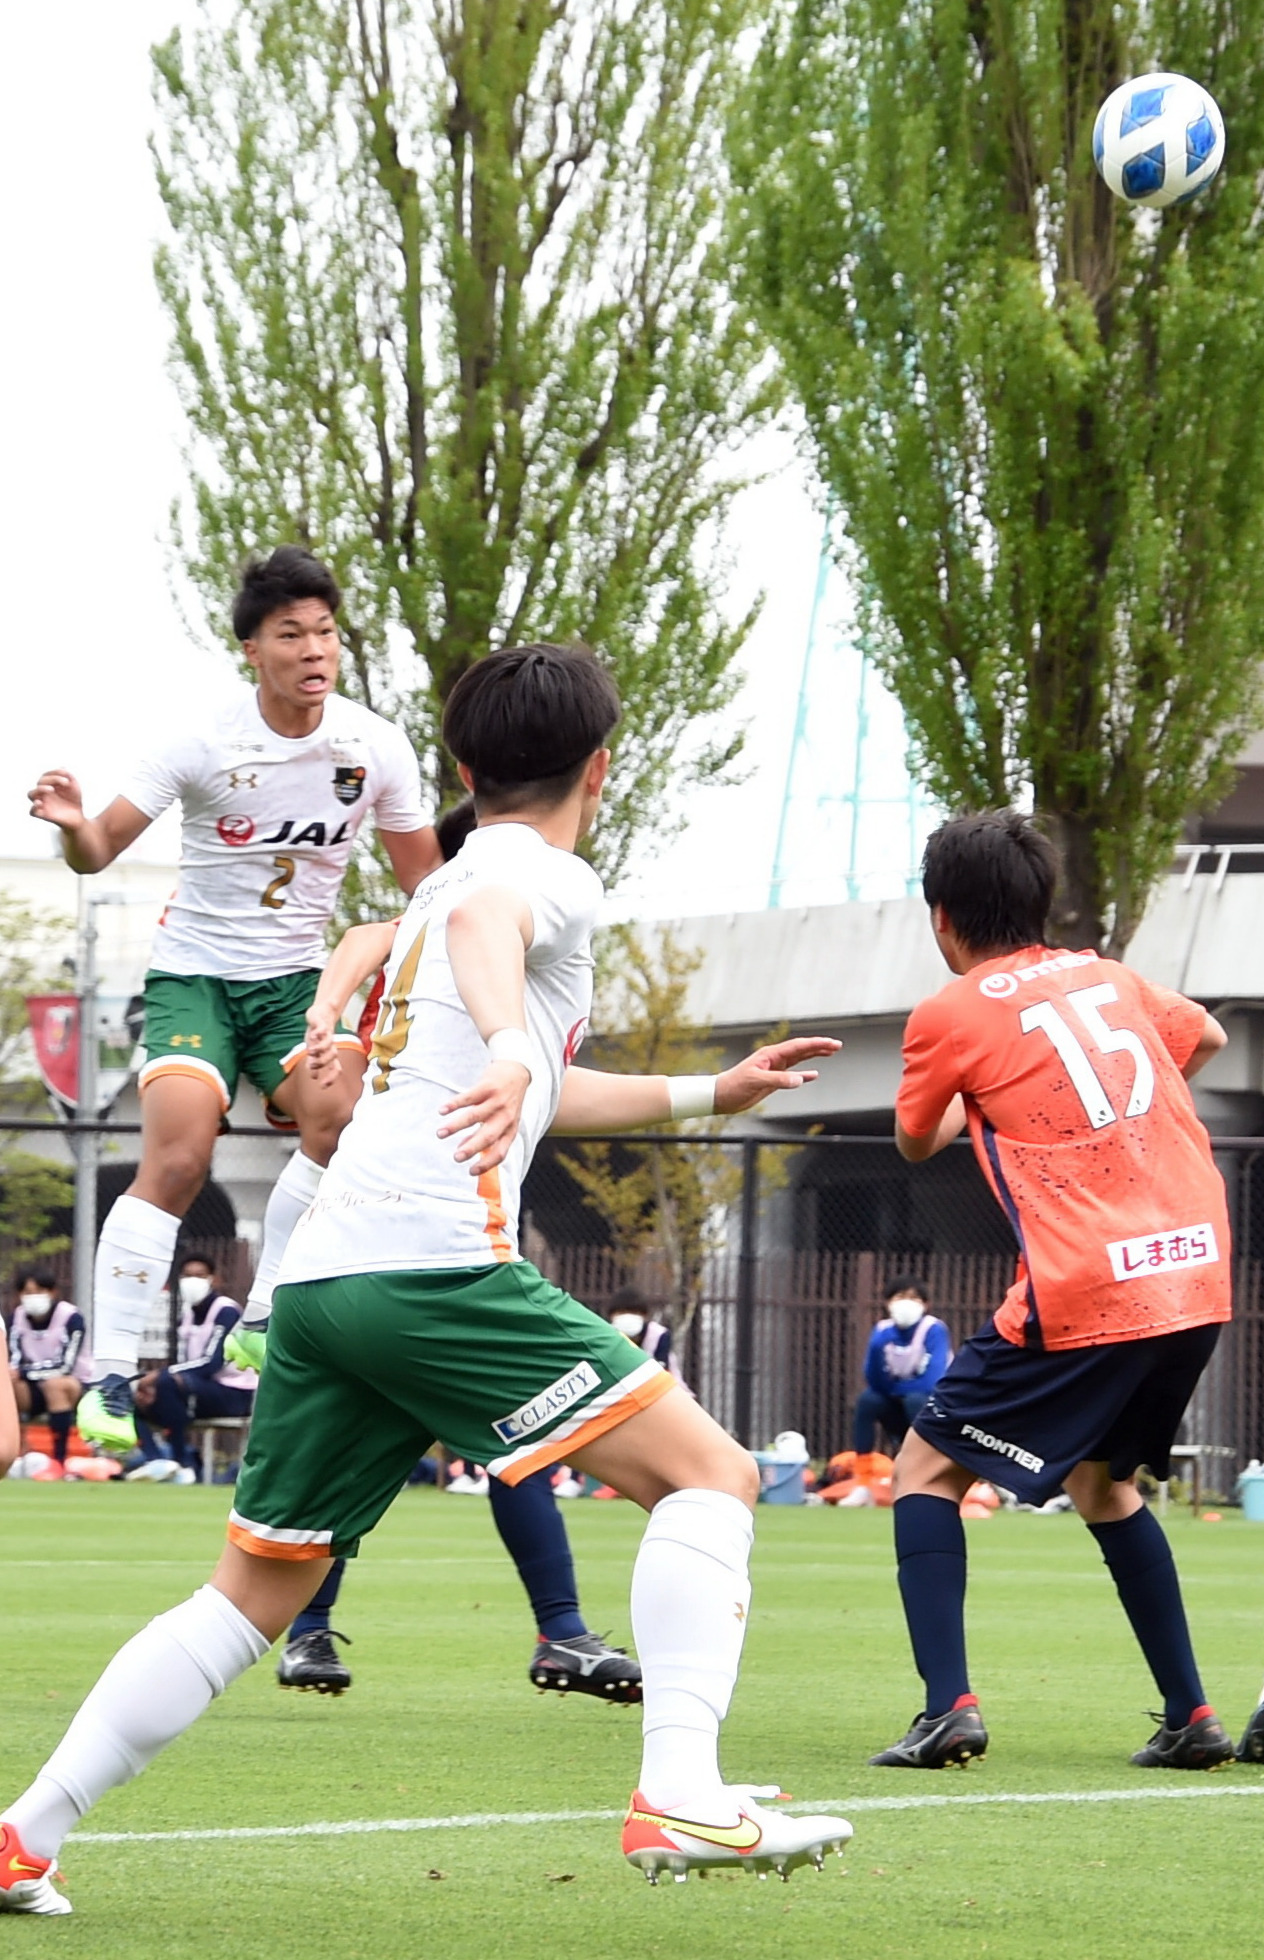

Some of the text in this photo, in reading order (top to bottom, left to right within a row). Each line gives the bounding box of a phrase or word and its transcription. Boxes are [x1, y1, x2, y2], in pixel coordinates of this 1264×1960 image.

[260, 856, 295, 909] 2
[1018, 982, 1155, 1131] 15
[1122, 1230, 1206, 1272] しまむら
[520, 1368, 591, 1428] CLASTY
[960, 1424, 1045, 1474] FRONTIER
